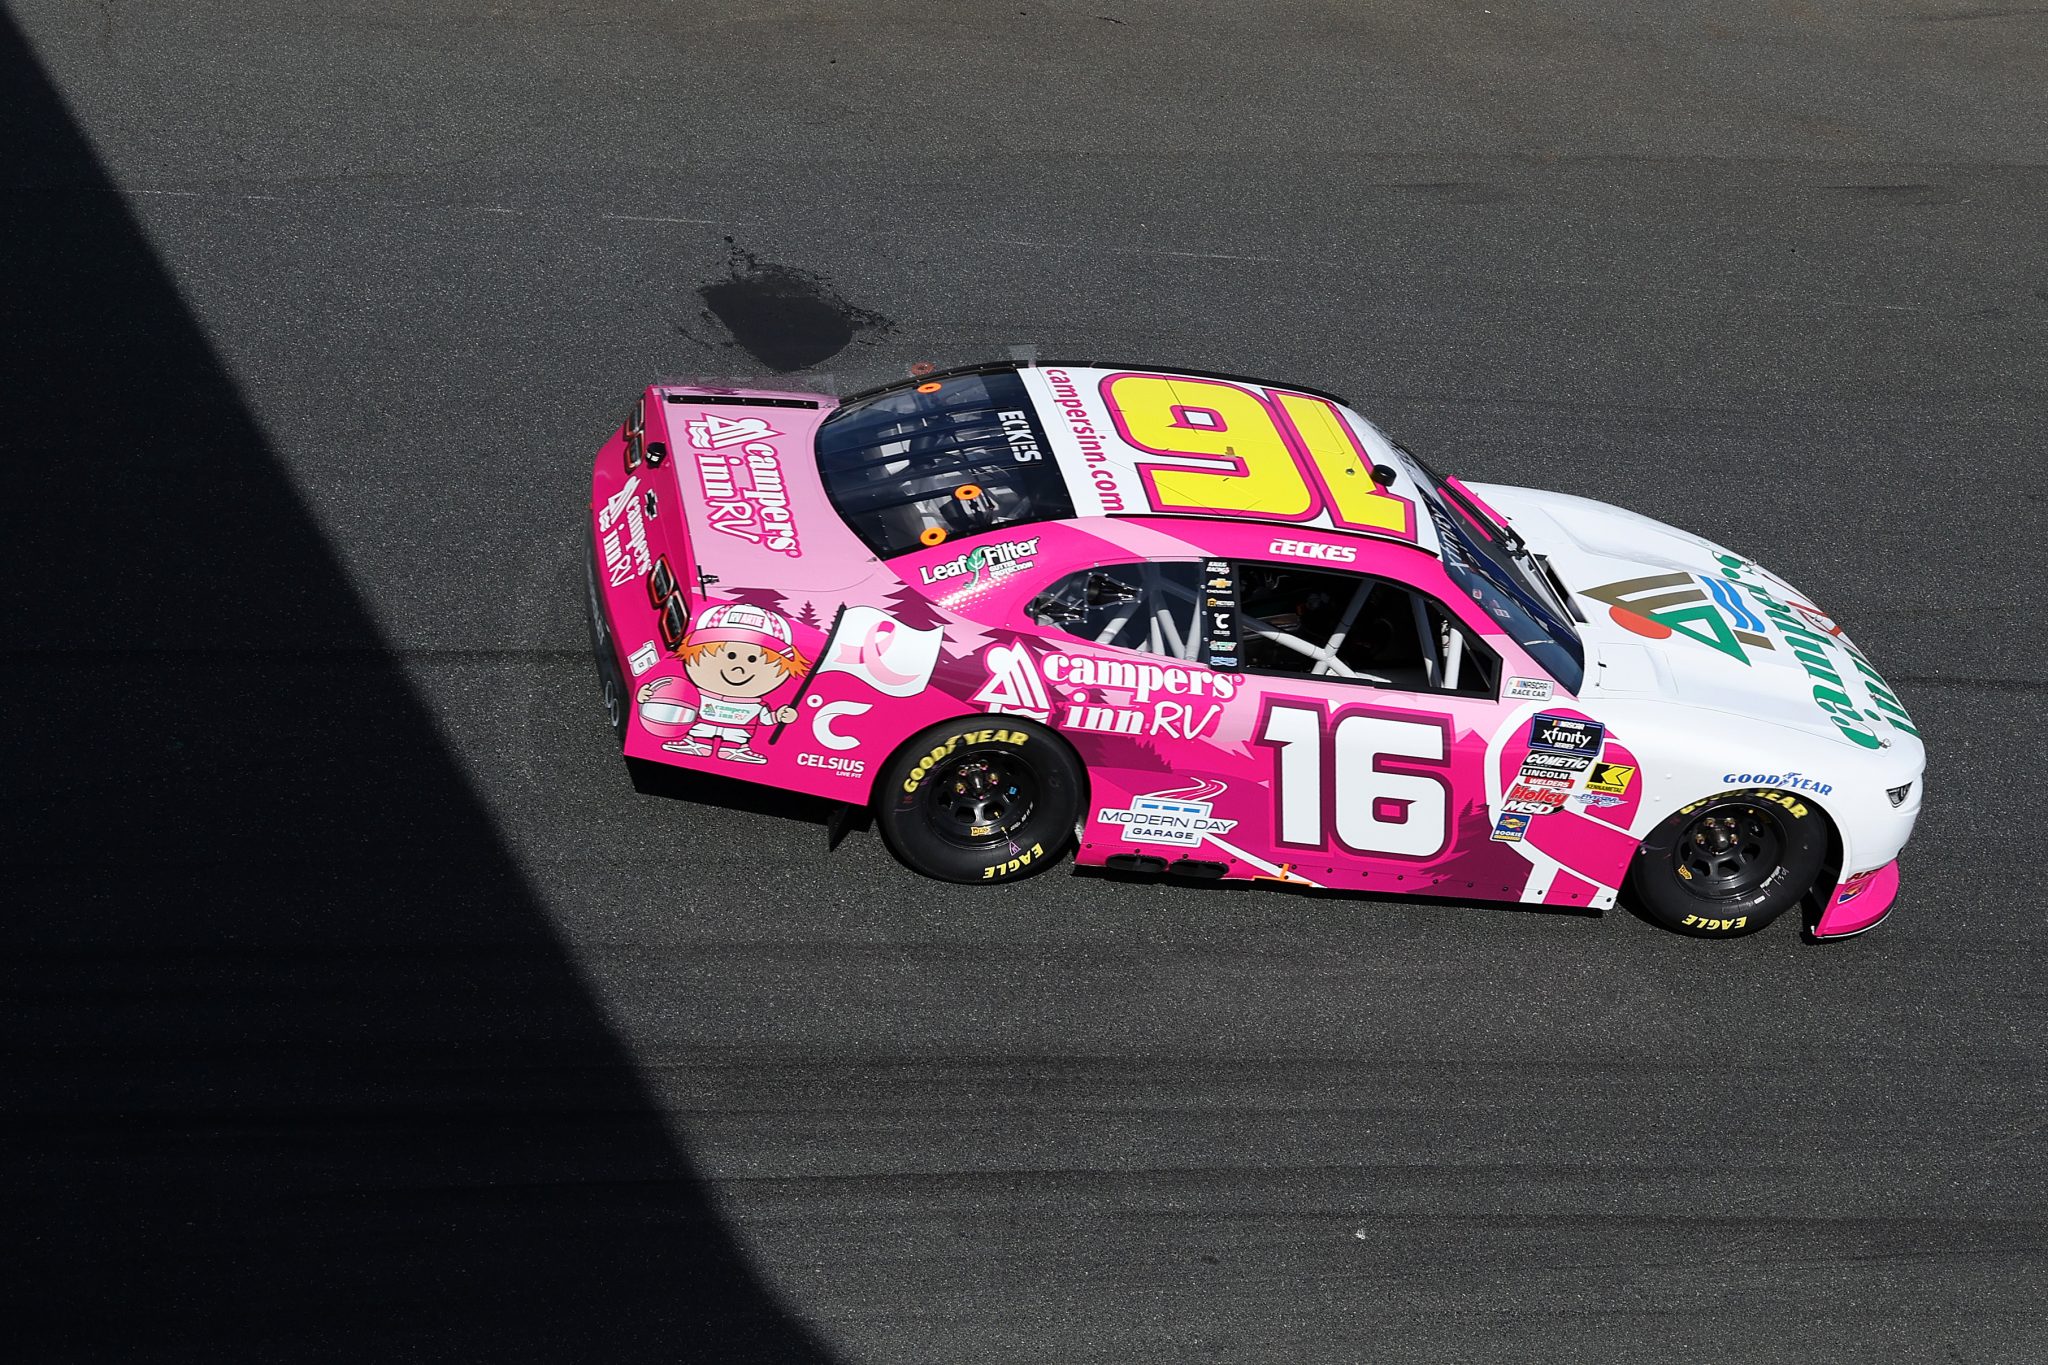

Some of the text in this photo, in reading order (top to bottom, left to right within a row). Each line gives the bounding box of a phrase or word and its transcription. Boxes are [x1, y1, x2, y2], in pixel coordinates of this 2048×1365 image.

[998, 410, 1043, 463] ECKES
[1046, 369, 1125, 512] campersinn.com
[1099, 372, 1418, 544] 16
[696, 454, 762, 544] inn RV
[743, 442, 801, 553] campers
[625, 495, 653, 577] campers
[608, 554, 636, 588] RV
[627, 640, 661, 678] 16
[1042, 653, 1236, 703] campers
[1511, 688, 1532, 696] RACE
[1063, 692, 1222, 740] inn RV
[1541, 727, 1592, 748] xfinity
[797, 752, 866, 773] CELSIUS
[903, 729, 1030, 794] GOODYEAR
[1521, 768, 1569, 780] LINCOLN
[1526, 753, 1590, 769] COMETIC
[1254, 697, 1455, 864] 16
[1509, 784, 1571, 808] Holley
[1528, 777, 1571, 788] WELDERS
[1723, 772, 1833, 796] GOODYEAR
[1100, 811, 1235, 832] MODERN DAY
[1502, 800, 1556, 815] MSD
[1132, 827, 1195, 840] GARAGE
[982, 842, 1044, 879] EAGLE
[1681, 914, 1748, 931] EAGLE
